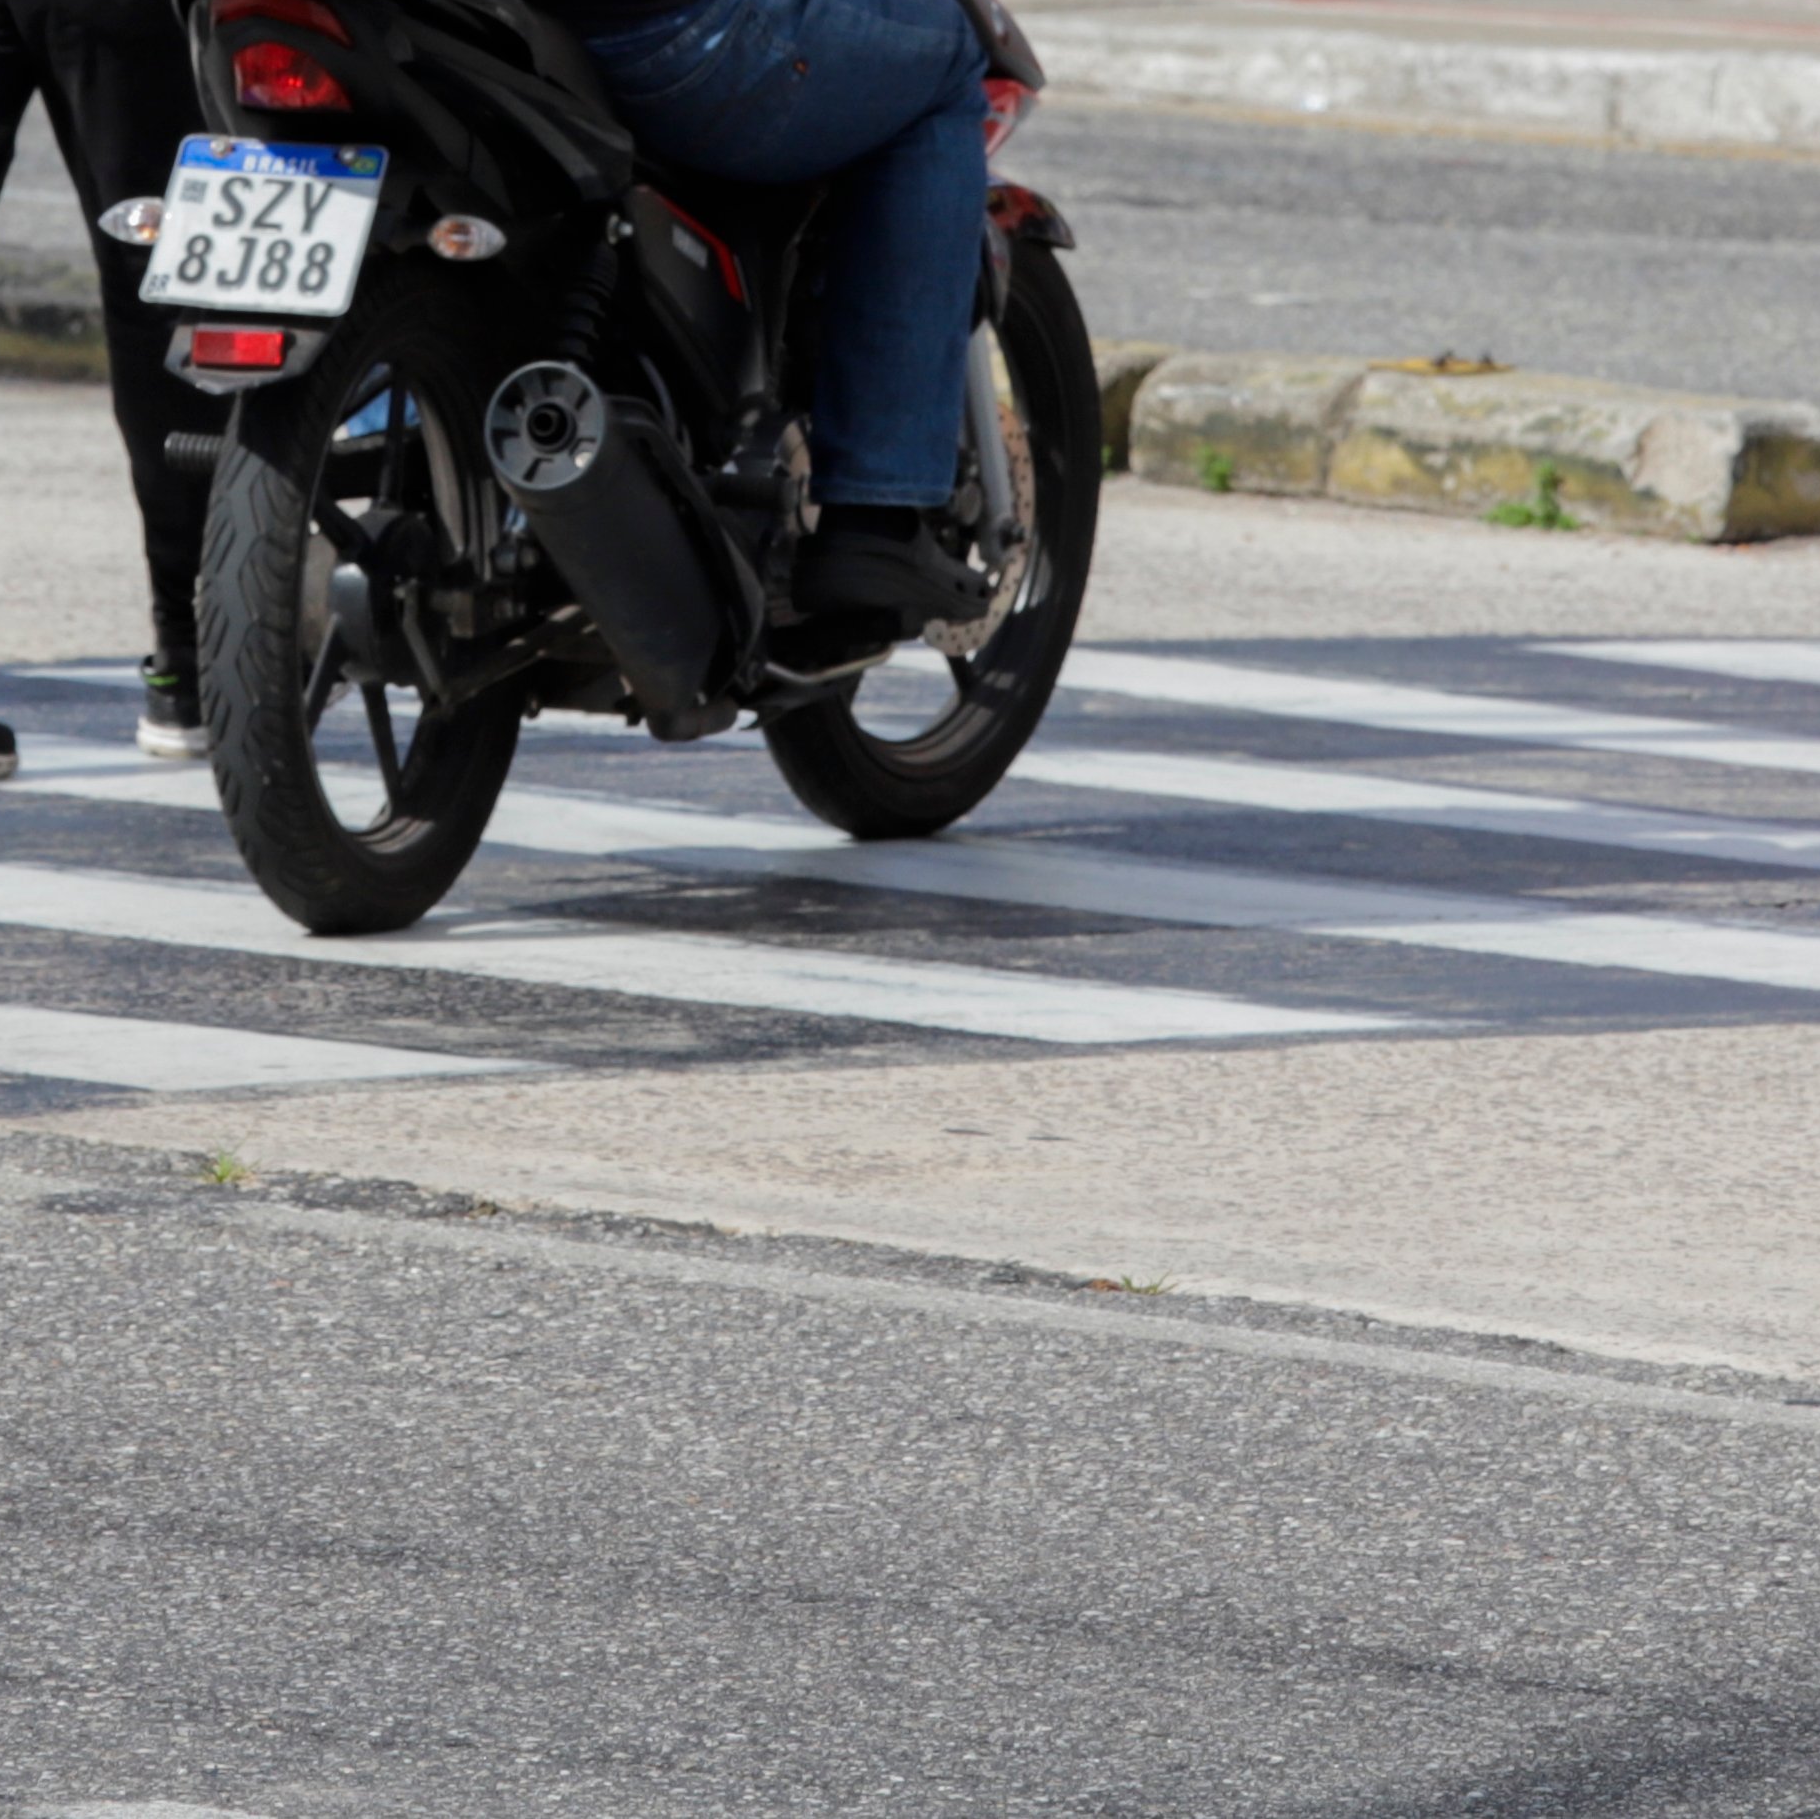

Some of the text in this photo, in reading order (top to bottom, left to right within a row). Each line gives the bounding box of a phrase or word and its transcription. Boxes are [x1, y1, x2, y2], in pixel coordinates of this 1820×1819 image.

[242, 155, 320, 176] BRASIL
[211, 175, 334, 236] SZY
[176, 234, 335, 297] 8J88
